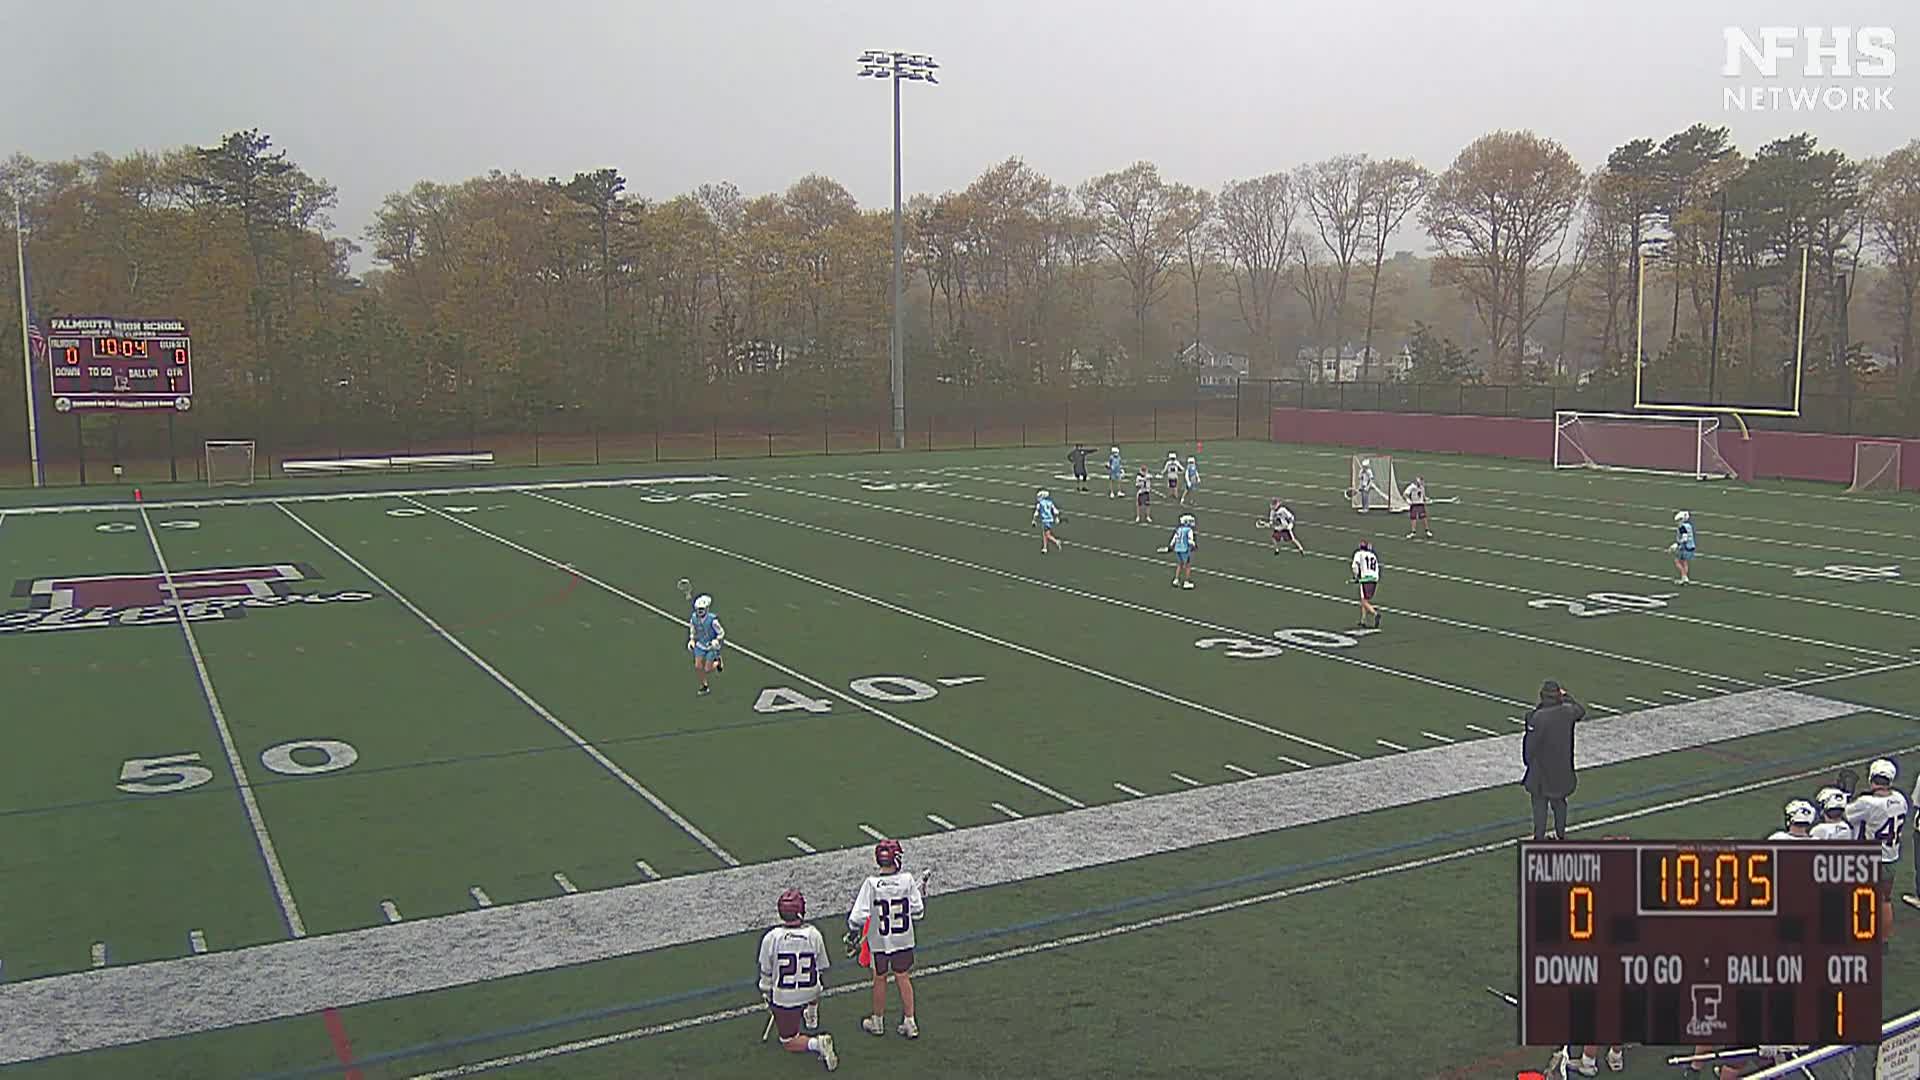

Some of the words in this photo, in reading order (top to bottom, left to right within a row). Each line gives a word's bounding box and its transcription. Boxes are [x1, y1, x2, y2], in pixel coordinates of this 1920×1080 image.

[51, 319, 112, 329] FALMOUTH
[114, 321, 141, 330] HIGH
[143, 322, 185, 331] SCHOOL
[100, 338, 146, 357] 10:04
[66, 347, 78, 364] 0
[175, 349, 186, 364] 0
[55, 367, 81, 377] DOWN
[88, 367, 99, 376] TO
[100, 367, 112, 376] GO
[128, 368, 147, 378] BALL
[873, 897, 909, 936] 33
[777, 952, 818, 989] 23
